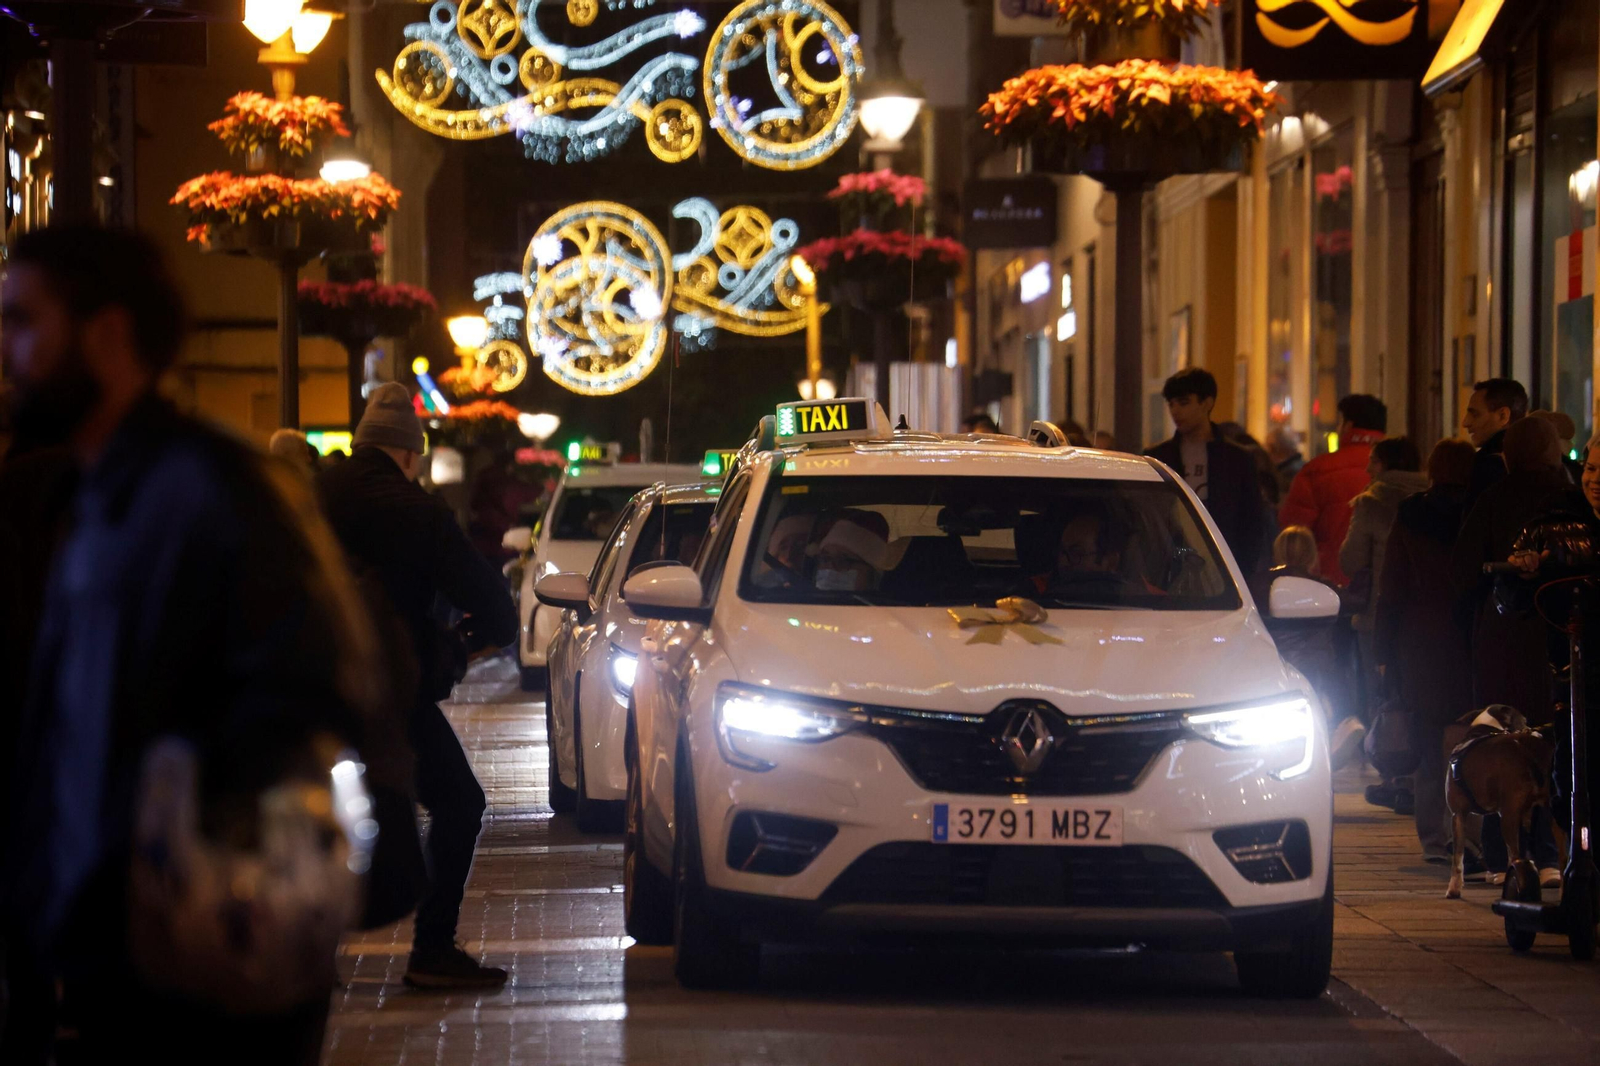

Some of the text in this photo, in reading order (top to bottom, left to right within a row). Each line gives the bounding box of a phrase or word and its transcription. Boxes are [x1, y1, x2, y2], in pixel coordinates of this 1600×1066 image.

[796, 404, 848, 432] TAXI
[957, 808, 1112, 839] 3791 MBZ
